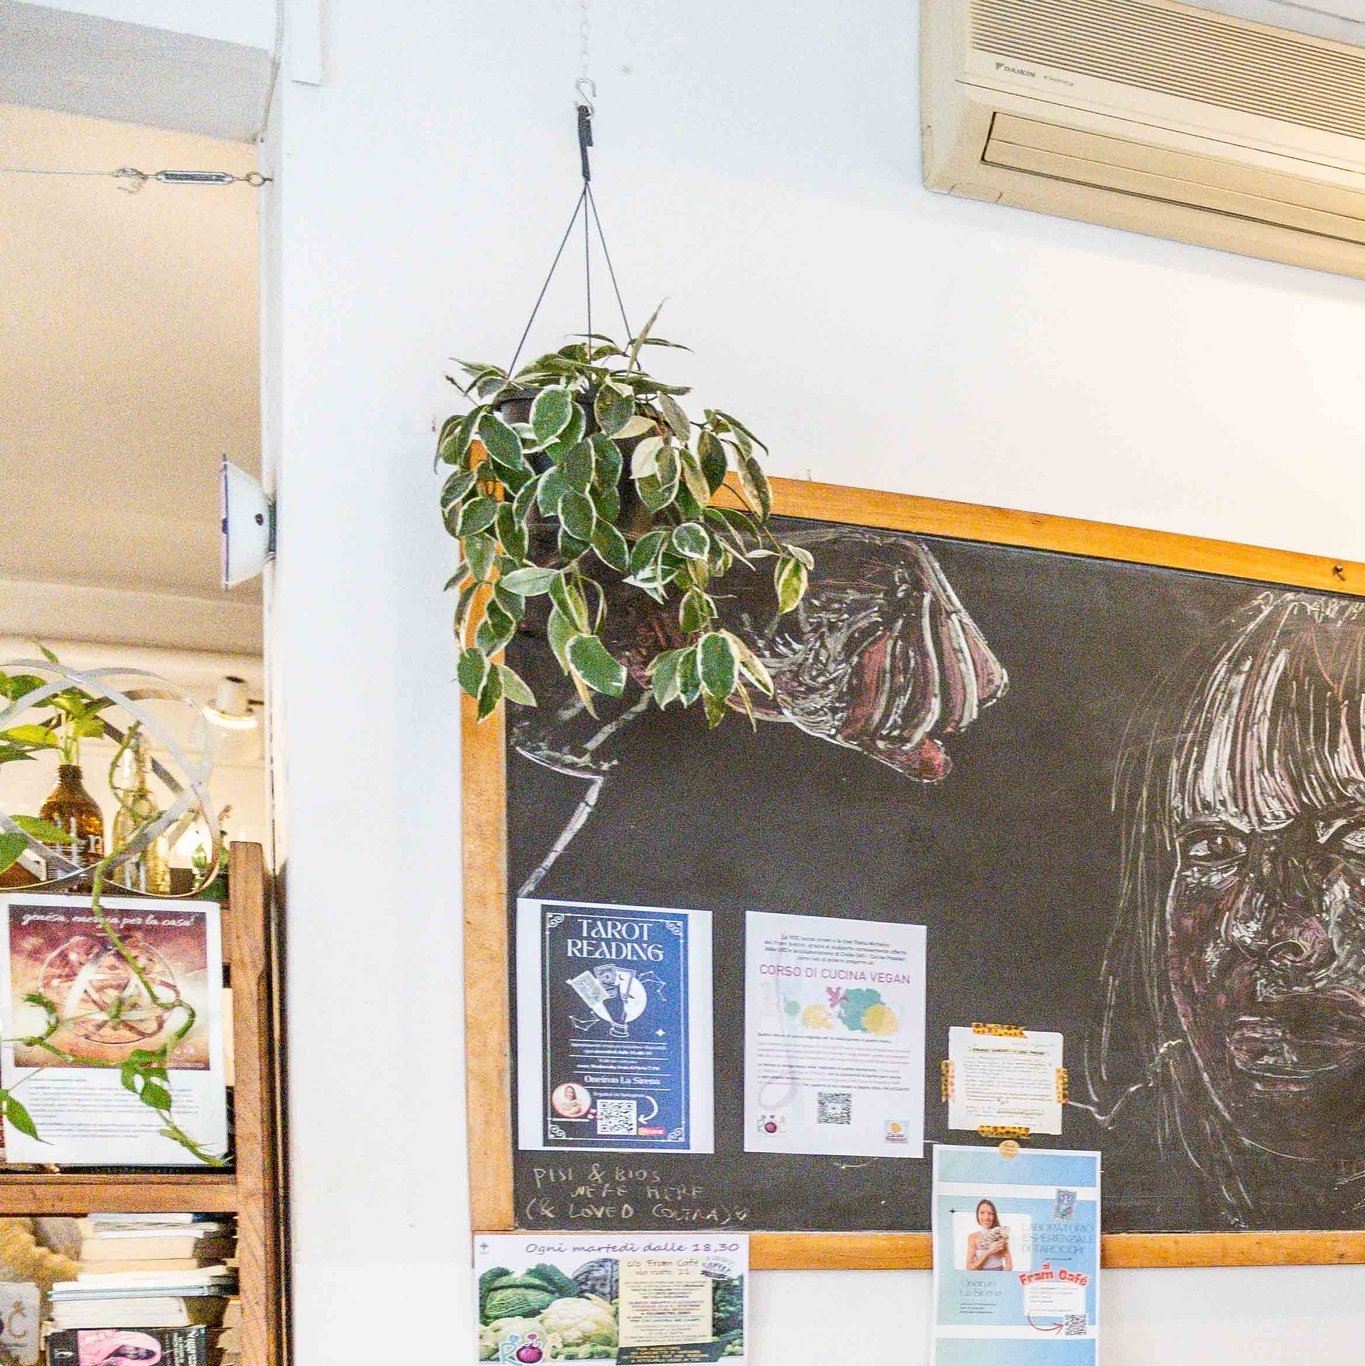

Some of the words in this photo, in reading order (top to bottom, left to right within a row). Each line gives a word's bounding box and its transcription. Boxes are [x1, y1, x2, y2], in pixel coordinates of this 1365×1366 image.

[1004, 65, 1035, 77] DAIKIN
[577, 919, 653, 941] TAROT
[566, 938, 664, 962] READING
[759, 963, 801, 977] CORSO
[805, 967, 817, 978] DI
[821, 968, 867, 981] CUCINA
[869, 972, 911, 985] VEGAN
[620, 1076, 632, 1084] La
[569, 1203, 634, 1219] LOVED
[526, 1243, 565, 1254] Ogni
[572, 1242, 641, 1253] martedì
[643, 1242, 688, 1252] dalle
[1020, 1271, 1054, 1285] Fram
[1058, 1269, 1088, 1286] Café
